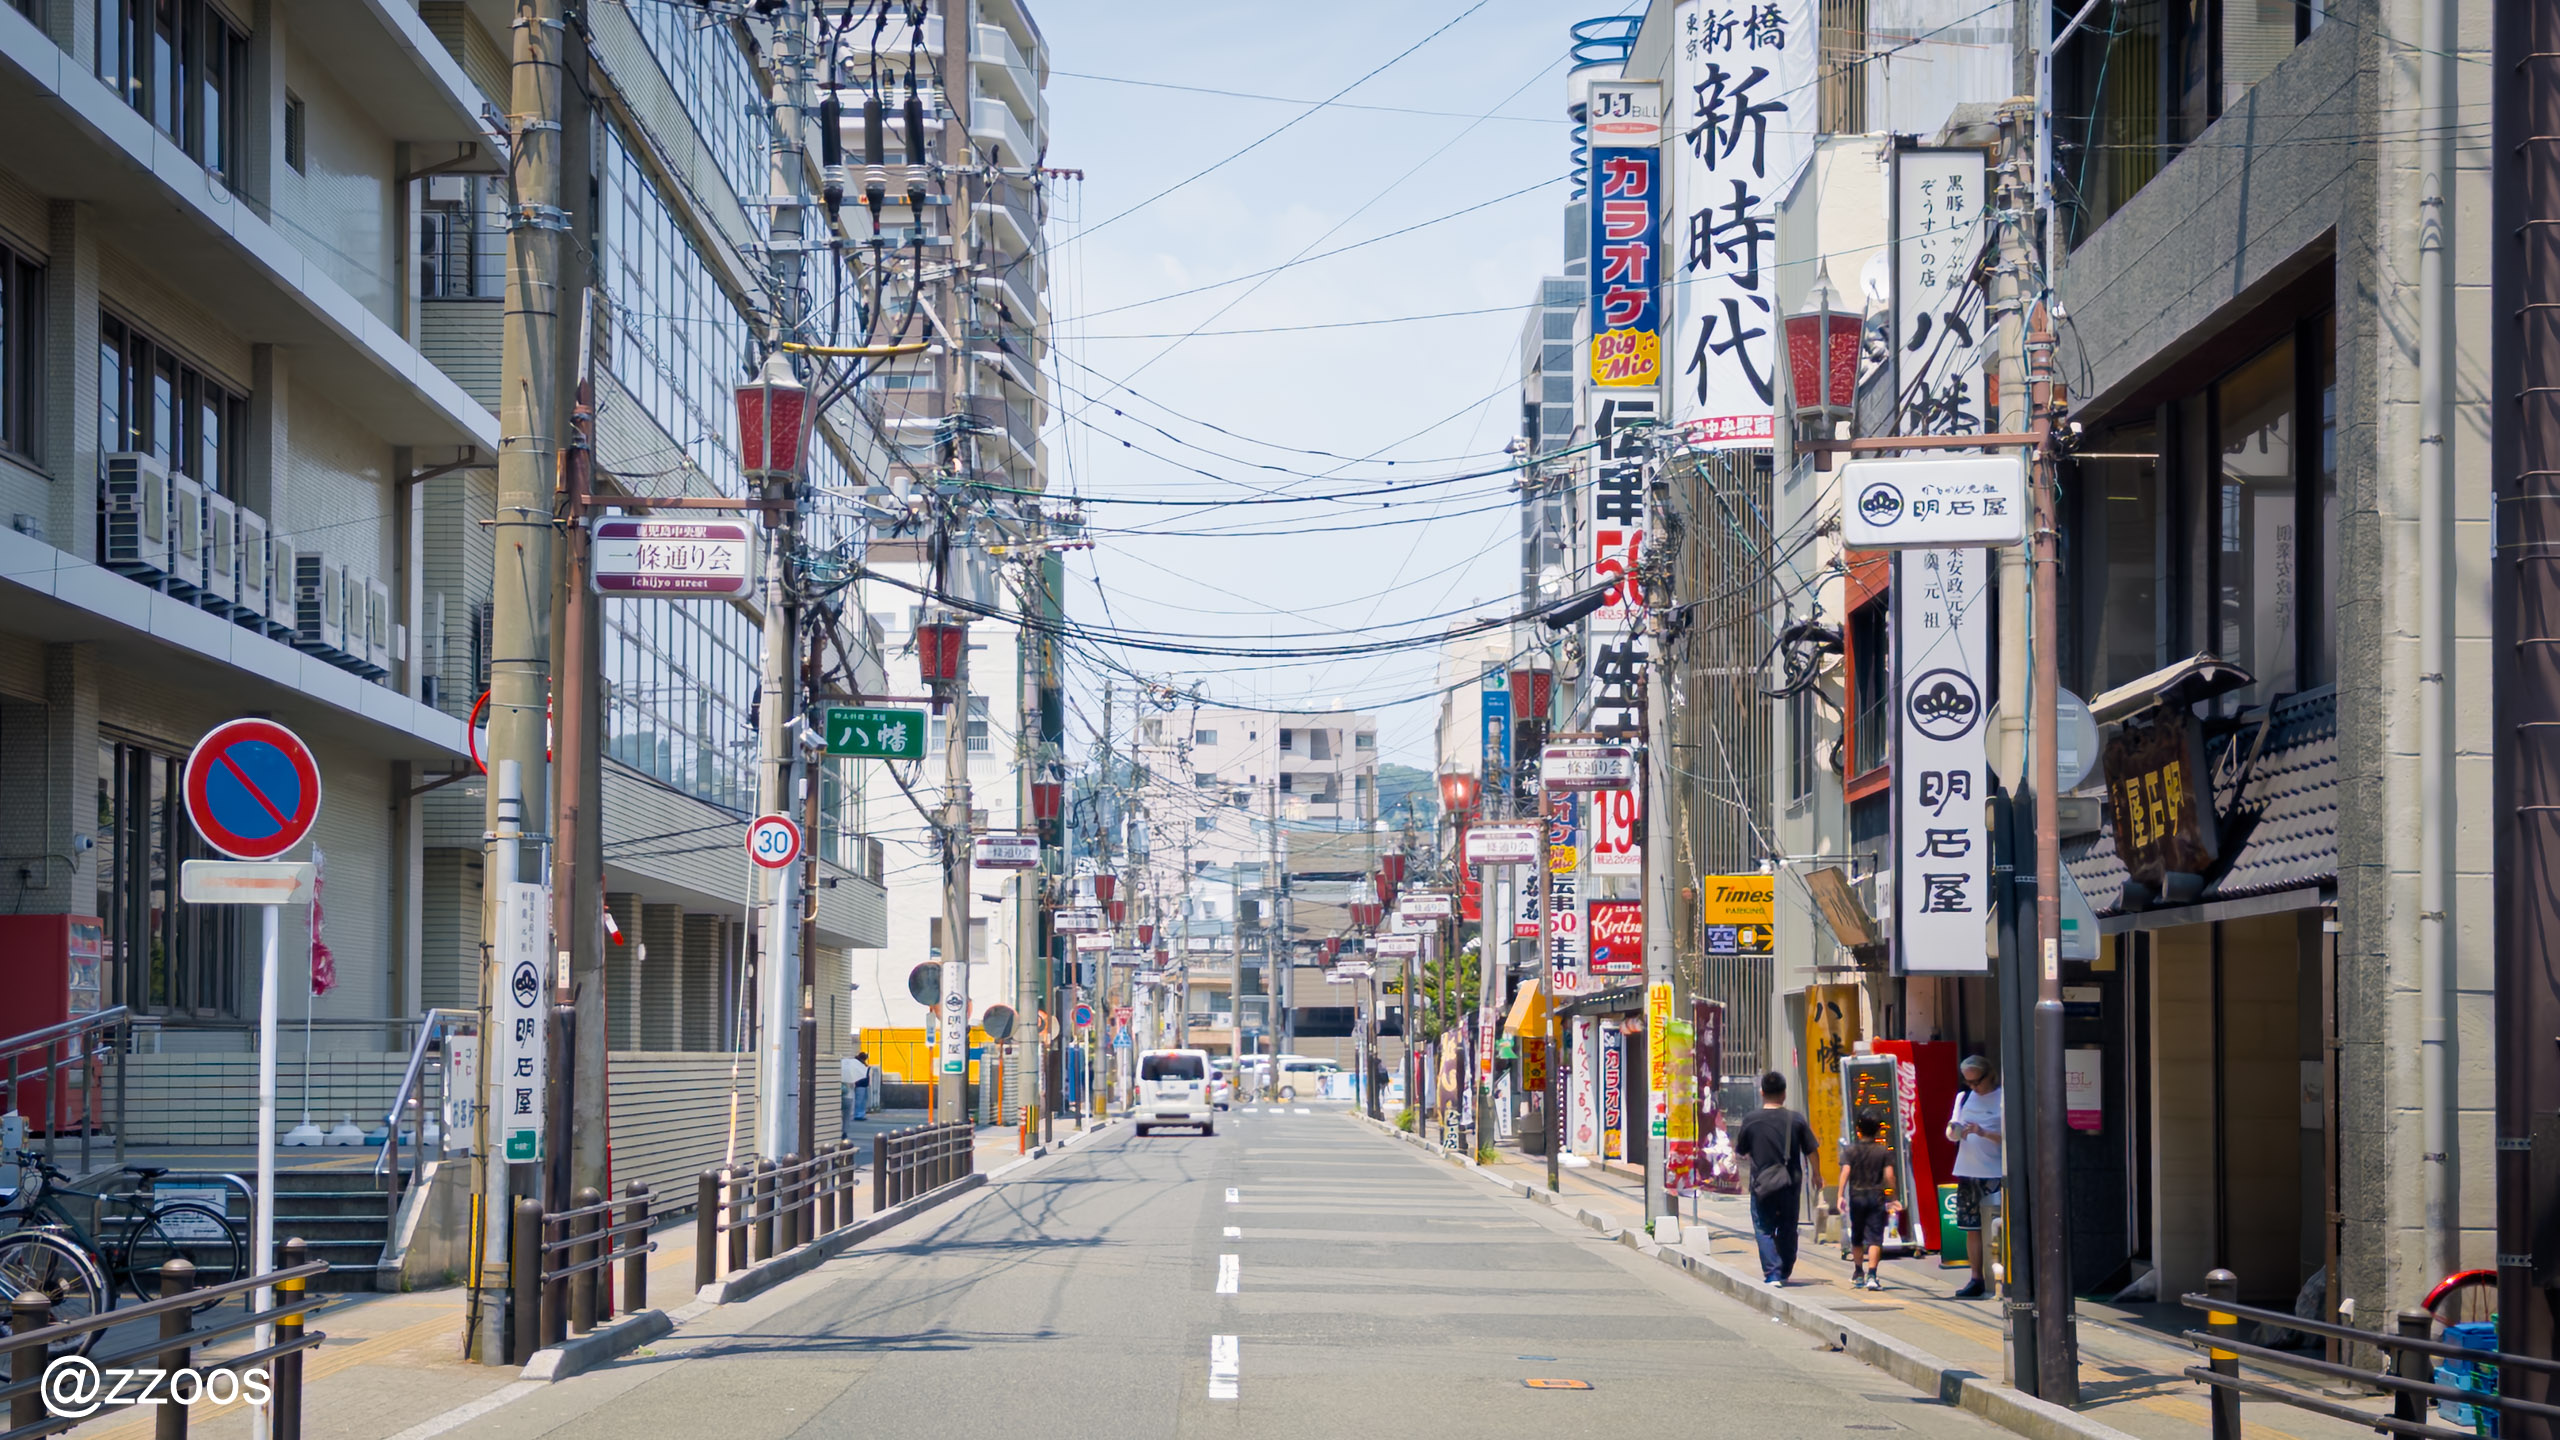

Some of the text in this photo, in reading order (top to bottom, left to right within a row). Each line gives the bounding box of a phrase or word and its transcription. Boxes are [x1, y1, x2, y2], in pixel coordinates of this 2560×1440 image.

[1686, 13, 1698, 61] 東京
[1700, 3, 1789, 54] 新橋
[1602, 157, 1650, 326] カラオケ
[1684, 63, 1788, 406] 新時代
[1920, 179, 1937, 288] ぞうすいの店
[1597, 334, 1636, 361] Big
[1603, 353, 1654, 379] Mic
[1913, 497, 2008, 522] 明石屋
[636, 525, 707, 538] 鹿児島中央駅
[609, 543, 732, 571] 一條通り会
[632, 577, 708, 588] Ichijyo street
[839, 721, 908, 752] 八幡
[758, 830, 789, 854] 30
[1916, 770, 1973, 914] 明石屋
[1715, 885, 1774, 903] Times
[1554, 971, 1577, 990] 90
[1814, 1001, 1845, 1074] 八幡
[513, 1017, 535, 1115] 明石屋
[1605, 1050, 1620, 1127] カラオケ
